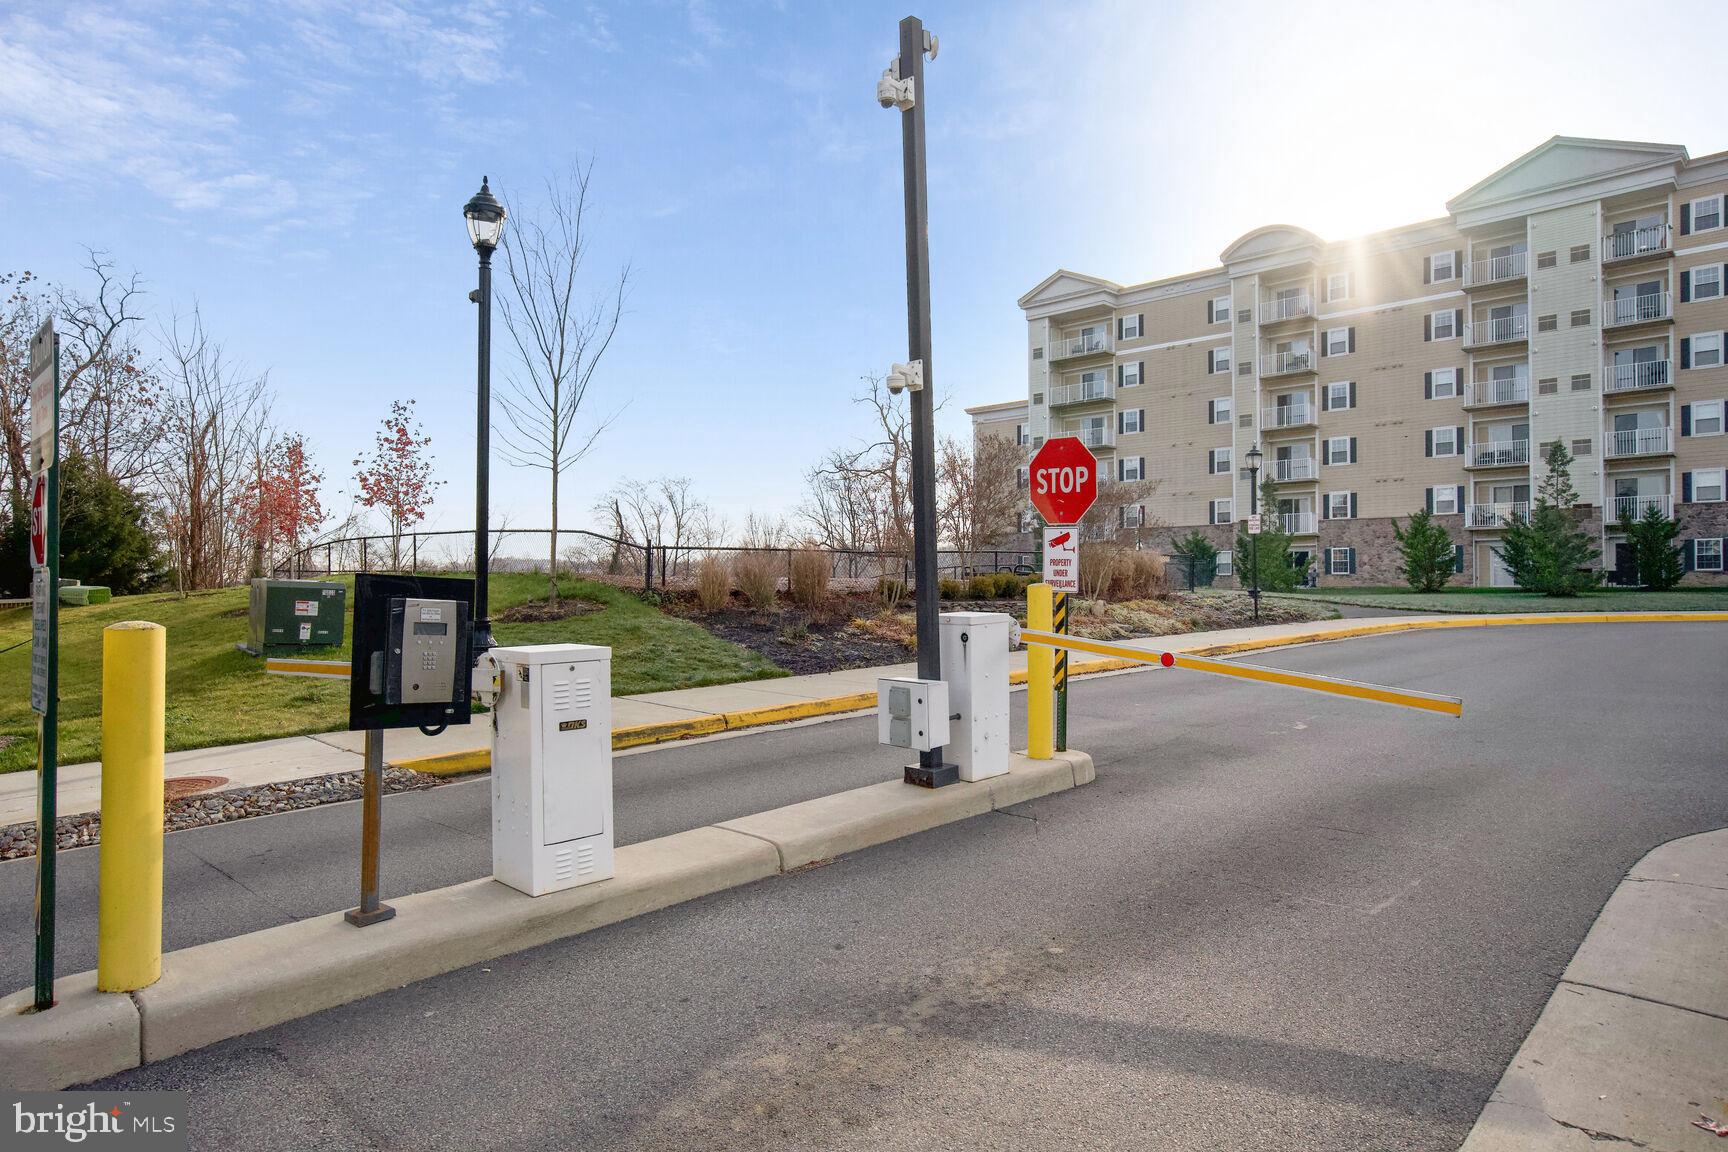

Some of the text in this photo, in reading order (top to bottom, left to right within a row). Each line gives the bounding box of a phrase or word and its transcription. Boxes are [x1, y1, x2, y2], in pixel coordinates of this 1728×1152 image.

[1036, 466, 1089, 494] STOP
[33, 506, 42, 536] ST
[1053, 569, 1068, 577] UNDER
